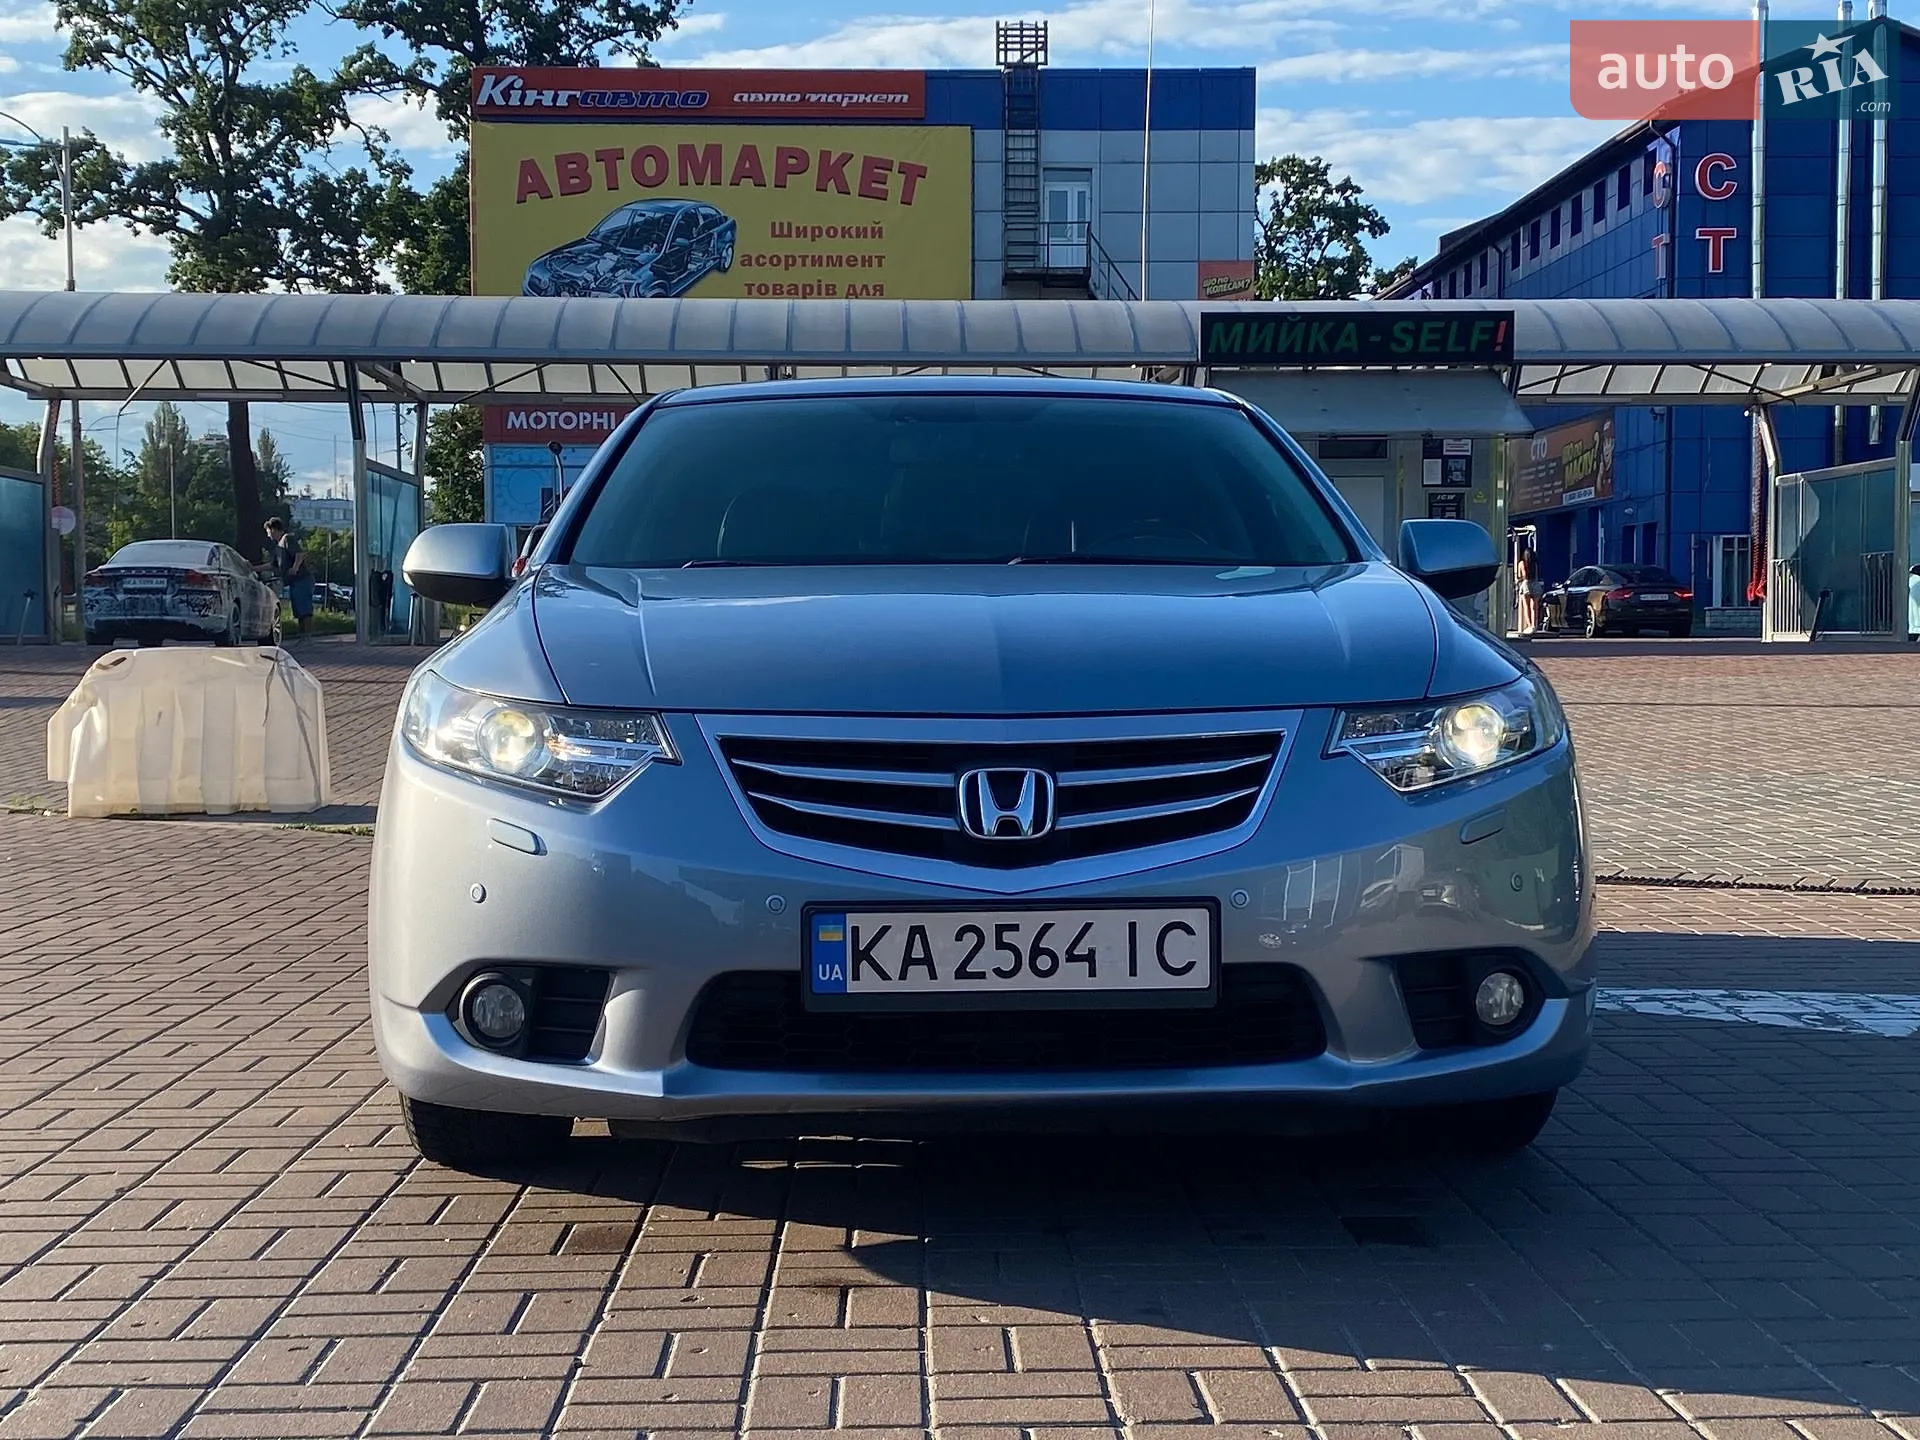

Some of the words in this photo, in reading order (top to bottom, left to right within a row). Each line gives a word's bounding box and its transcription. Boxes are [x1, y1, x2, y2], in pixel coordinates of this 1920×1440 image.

[733, 93, 801, 103] авто
[516, 143, 928, 206] АВТОМАРКЕТ
[770, 221, 884, 241] Широкий
[739, 253, 886, 272] асортимент
[744, 280, 837, 298] товарів
[845, 284, 885, 298] для
[1208, 316, 1359, 353] МИЙКА
[1390, 320, 1507, 352] SELF!
[850, 924, 939, 981] KA
[954, 921, 1097, 981] 2564
[1127, 920, 1197, 977] IC
[818, 964, 843, 981] UA
